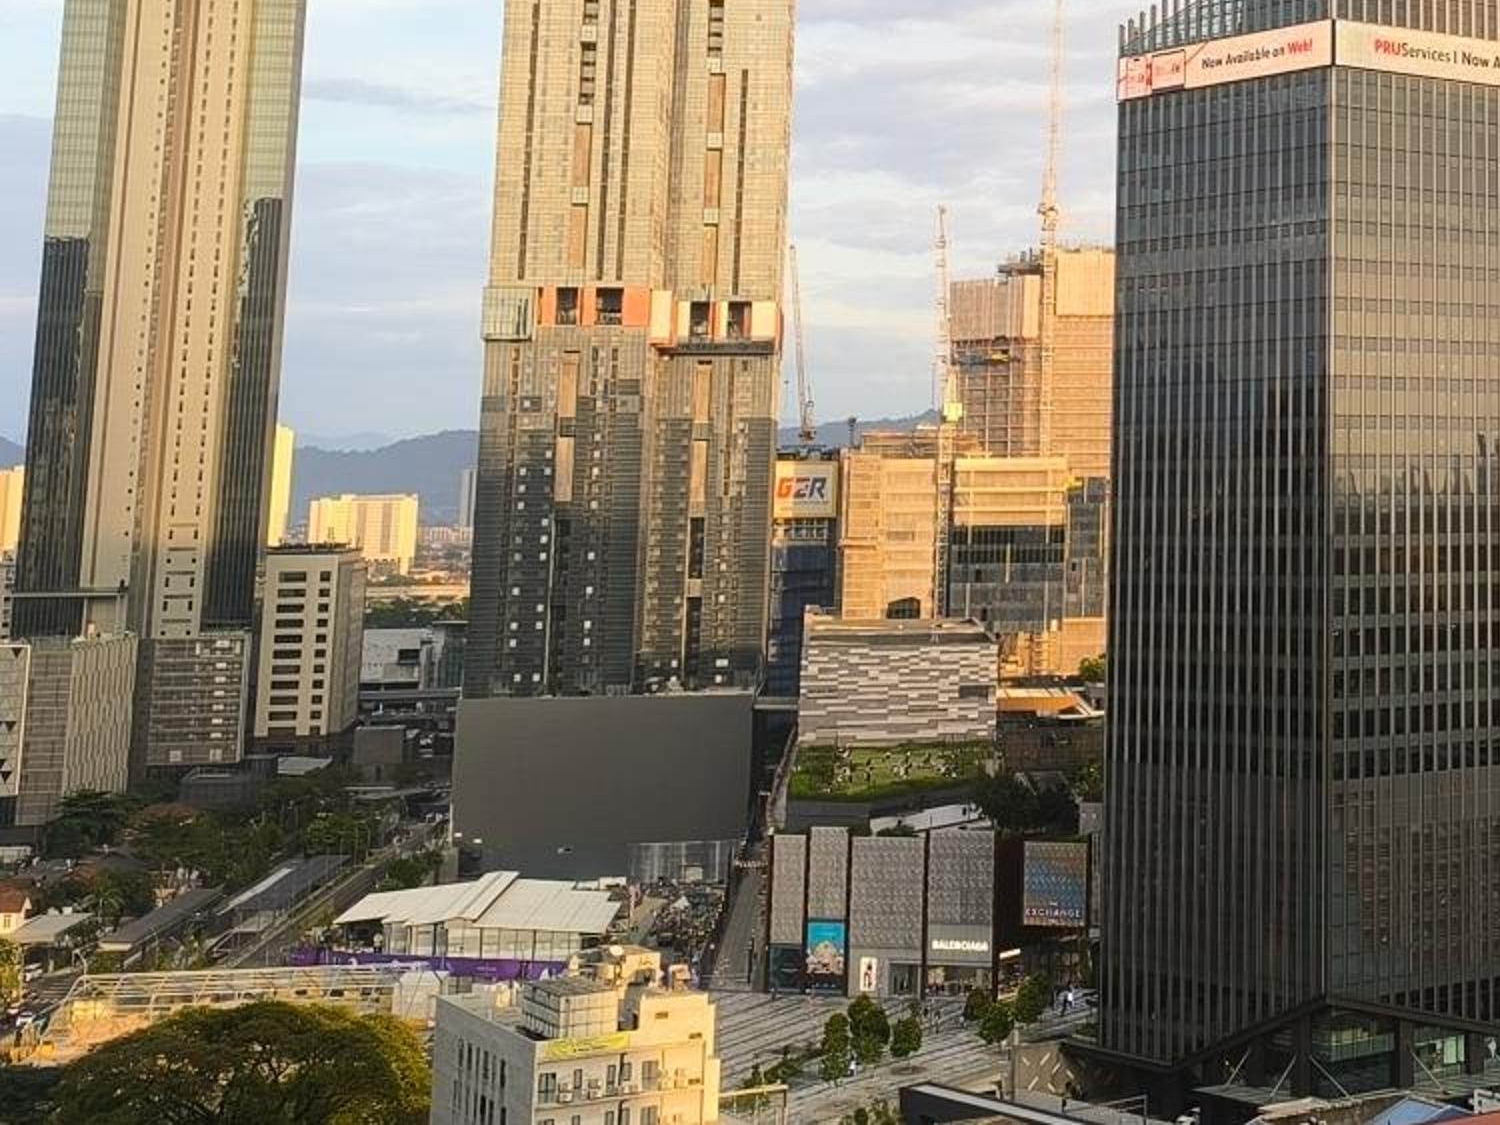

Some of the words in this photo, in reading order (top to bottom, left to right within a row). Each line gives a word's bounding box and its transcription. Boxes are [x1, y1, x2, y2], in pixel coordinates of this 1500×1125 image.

[1201, 57, 1222, 69] Now
[1226, 49, 1270, 67] Available
[1272, 47, 1285, 58] on
[1287, 38, 1313, 56] Web!
[1375, 39, 1450, 62] PRUServices
[1461, 53, 1489, 68] Now
